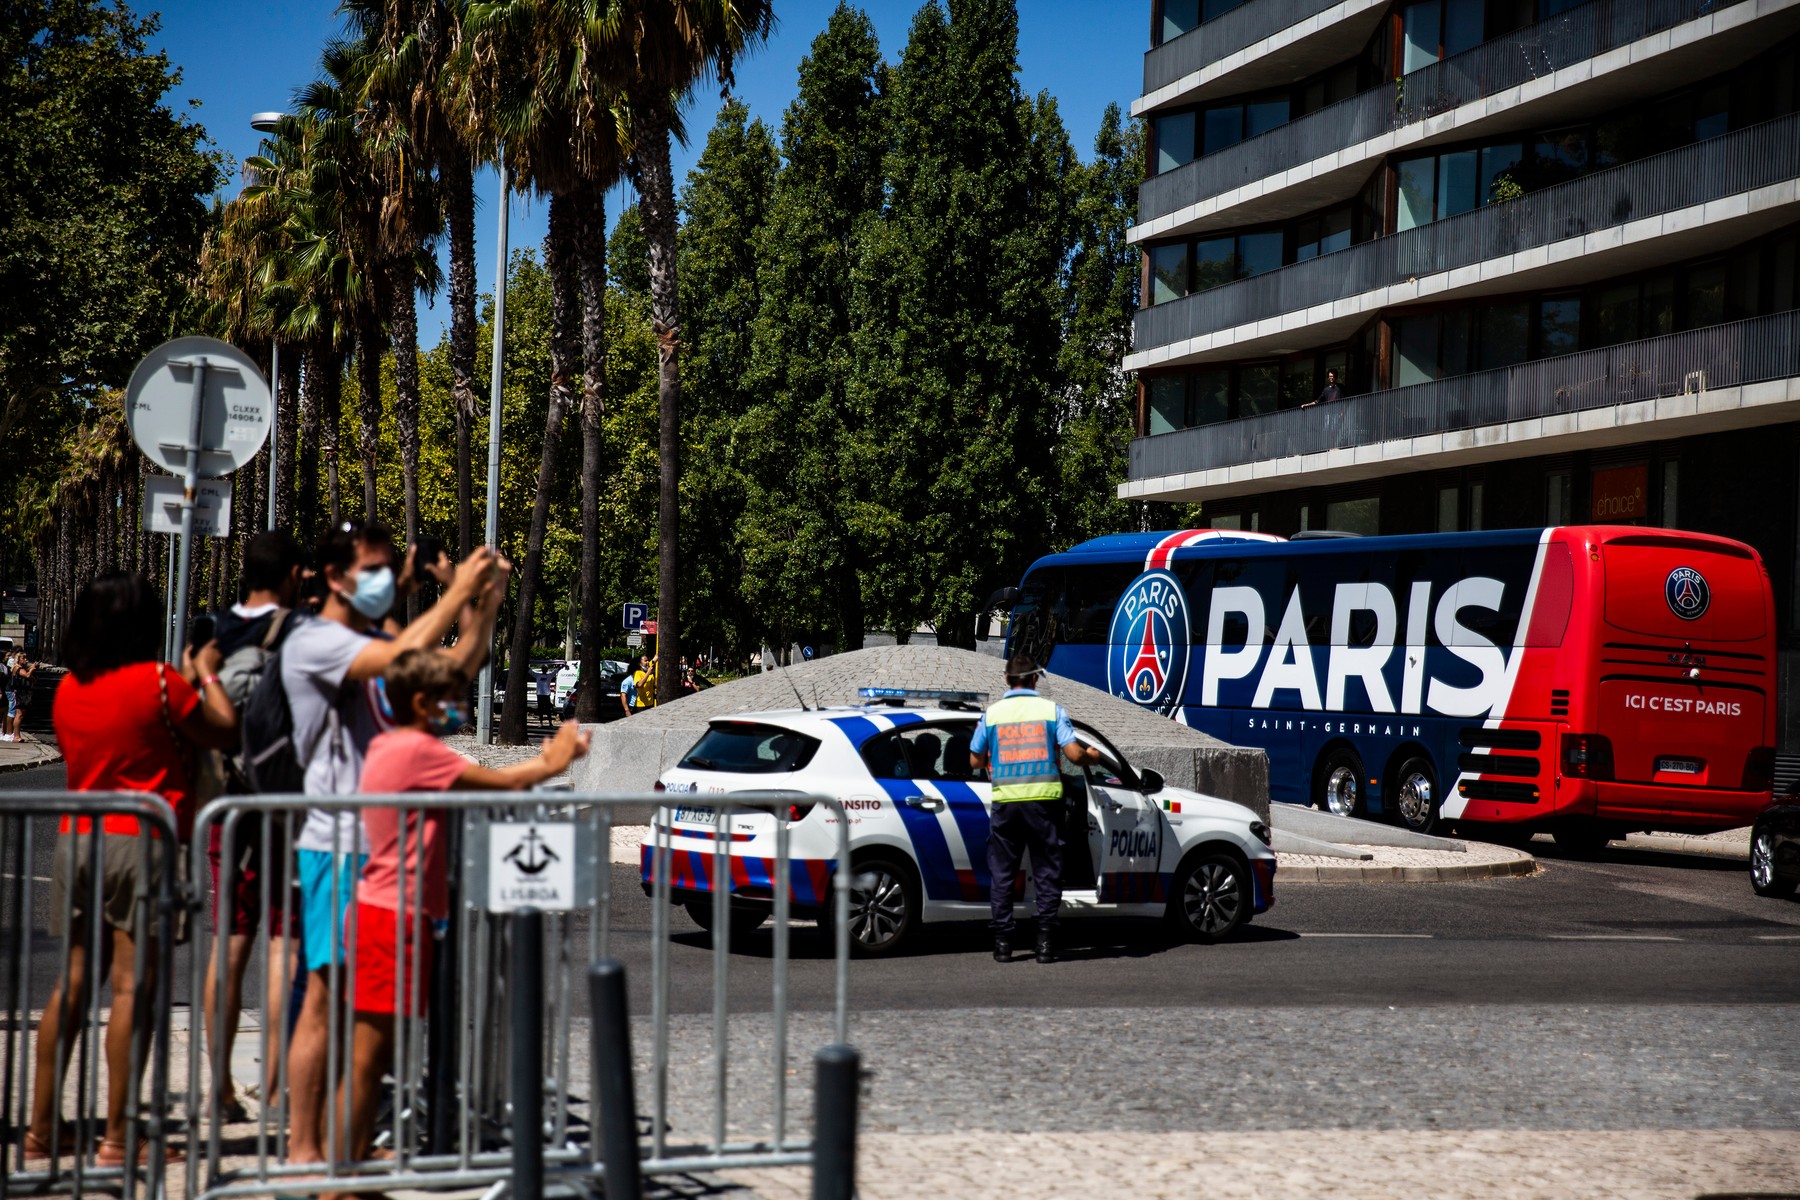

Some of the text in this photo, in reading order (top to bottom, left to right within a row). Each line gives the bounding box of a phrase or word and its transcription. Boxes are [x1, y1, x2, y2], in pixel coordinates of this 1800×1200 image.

[132, 402, 152, 411] CML
[201, 488, 220, 497] CML
[1597, 492, 1635, 516] choice
[1672, 570, 1701, 584] PARIS
[1124, 581, 1178, 621] PARIS
[629, 607, 642, 625] P
[1201, 576, 1505, 717] PARIS
[1625, 694, 1741, 716] ICI C'EST PARIS
[1248, 718, 1420, 737] SAINT-GERMAIN
[500, 887, 560, 901] LISBOA
